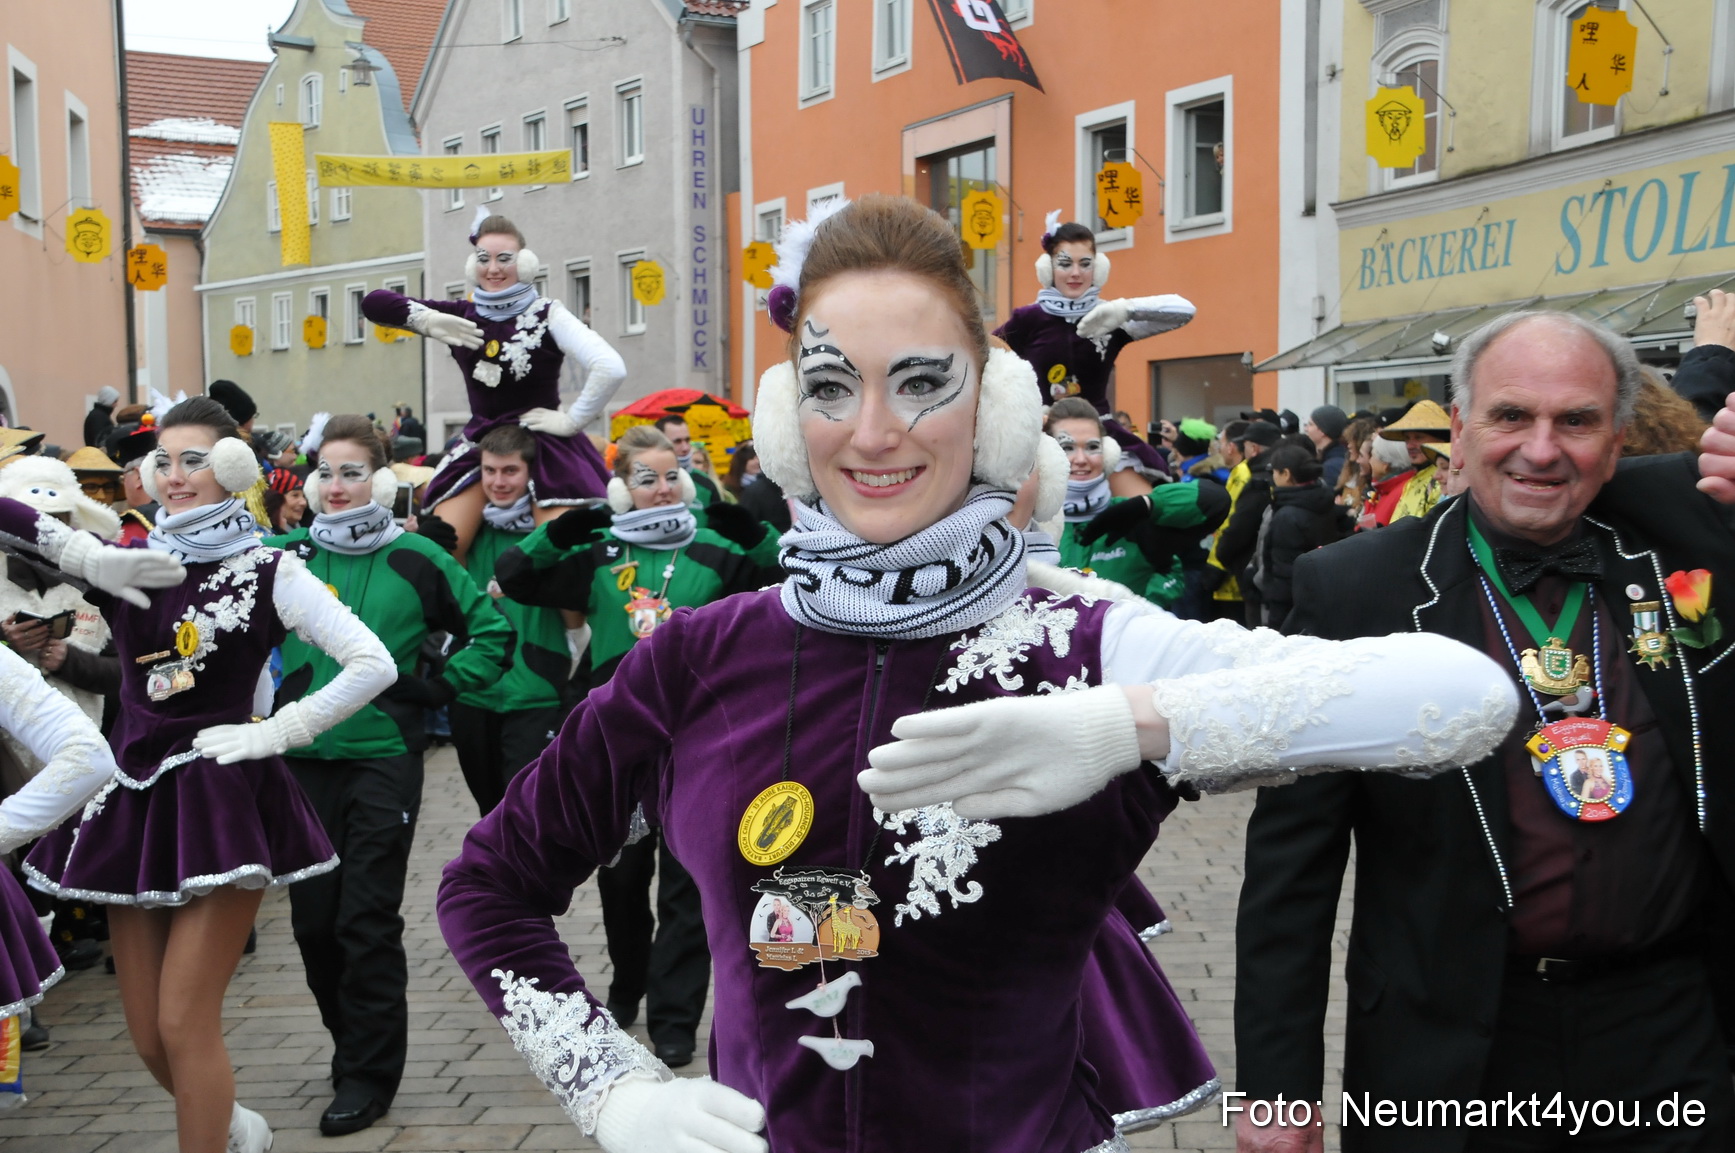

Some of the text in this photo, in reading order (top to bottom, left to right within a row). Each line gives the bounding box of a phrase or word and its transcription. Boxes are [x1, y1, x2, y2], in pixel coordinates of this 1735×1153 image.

[691, 107, 707, 368] UHREN SCHMUCK
[1359, 218, 1517, 290] BÄCKEREI
[758, 789, 776, 803] JAHRE
[777, 784, 799, 792] KAISER
[742, 815, 753, 835] CHINA
